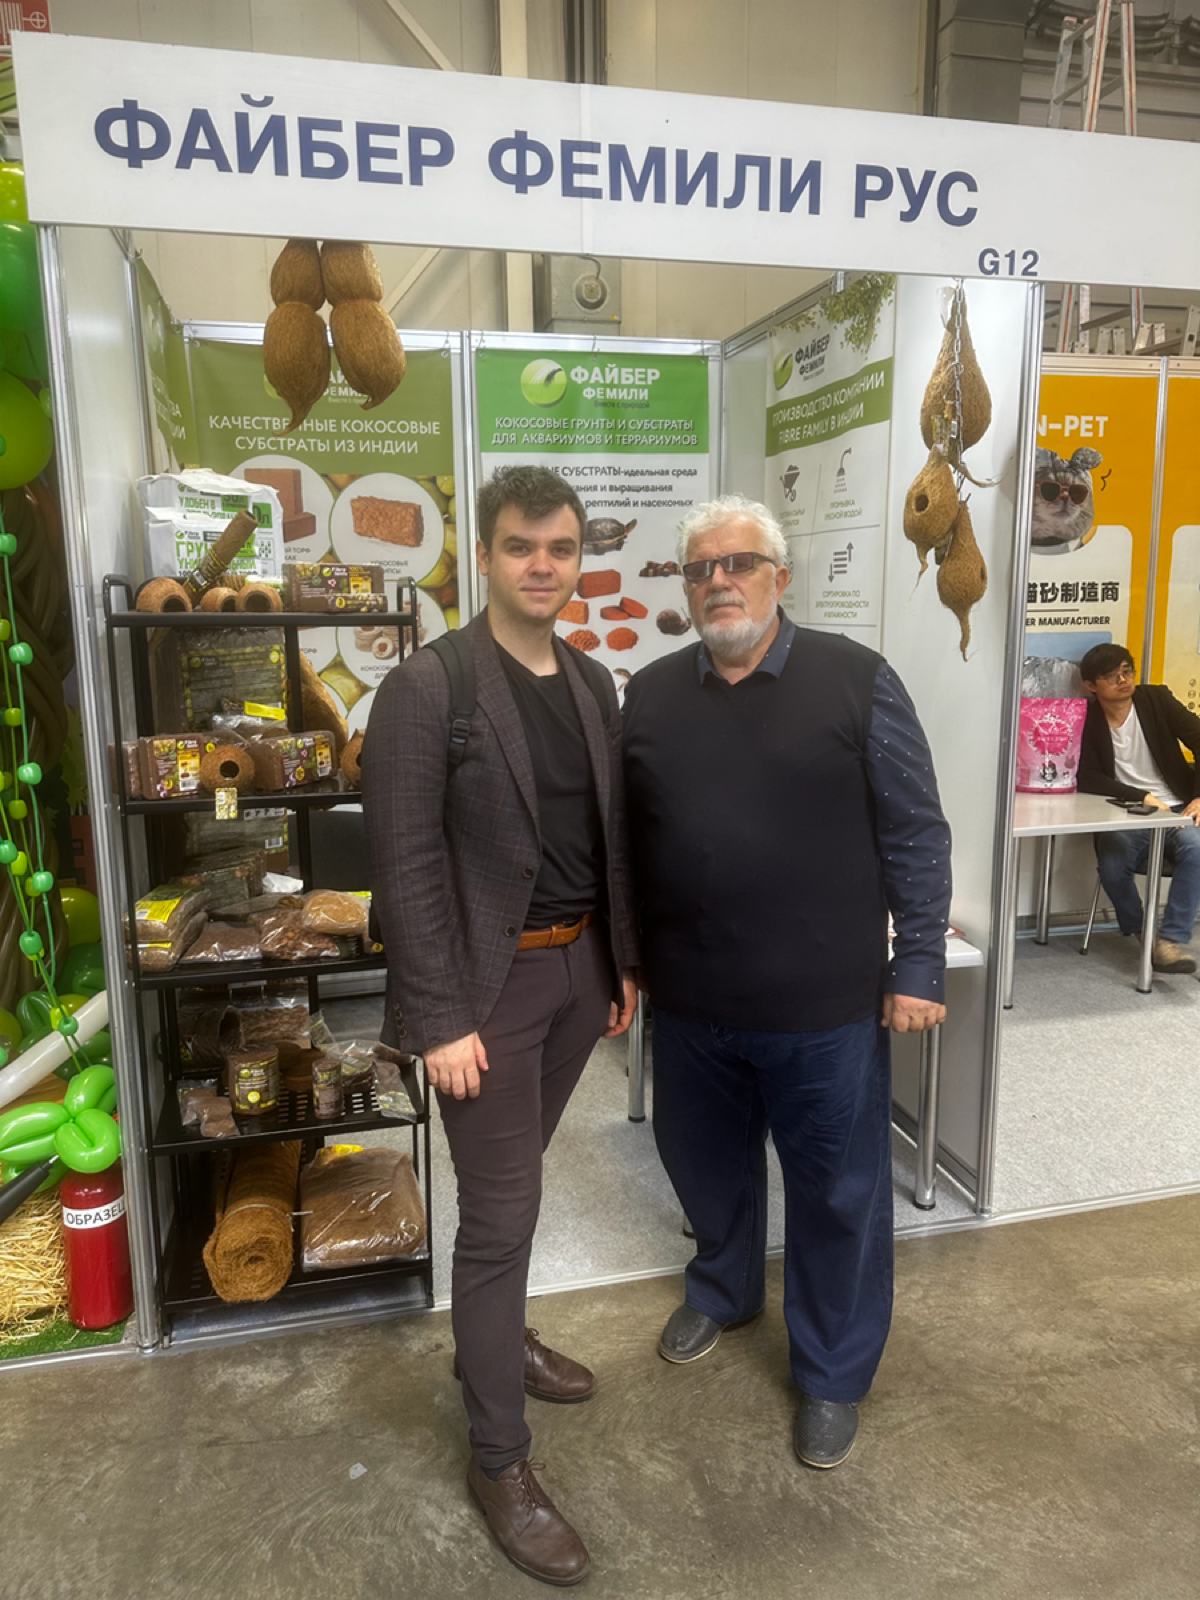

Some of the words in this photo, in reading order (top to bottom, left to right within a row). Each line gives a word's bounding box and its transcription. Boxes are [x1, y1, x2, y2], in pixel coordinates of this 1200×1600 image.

[94, 94, 454, 187] ФАЙБЕР
[488, 130, 822, 215] ФЕМИЛИ
[855, 164, 977, 227] РУС
[978, 248, 1038, 276] G12
[795, 333, 830, 364] ФАЙБЕР
[570, 363, 660, 385] ФАЙБЕР
[582, 386, 649, 401] ФЕМИЛИ
[832, 370, 885, 406] КОМПАНИИ
[208, 415, 337, 433] КАЧЕСТВЕНЫЕ
[341, 419, 441, 435] КОКОСОВЫЕ
[495, 416, 568, 430] КОКОСОВЫЕ
[571, 418, 615, 431] ГРУНТЫ
[618, 419, 626, 431] И
[628, 419, 694, 431] СУБСТРАТЫ
[491, 432, 517, 446] ДЛЯ
[522, 433, 602, 445] АКВАРИУМОВ
[604, 434, 613, 445] И
[615, 434, 698, 446] ТЕРРАРИУМОВ
[779, 426, 801, 445] FIBRE
[235, 436, 330, 453] СУБСТРАТЫ
[335, 439, 355, 453] ИЗ
[359, 440, 418, 455] ИНДИИ
[671, 468, 698, 478] среда
[573, 484, 598, 493] ания
[600, 485, 607, 493] и
[608, 484, 673, 495] выращивания
[584, 497, 631, 509] рептилий
[632, 499, 639, 507] и
[640, 499, 693, 508] насекомых
[175, 541, 214, 559] ГРУН
[1038, 615, 1111, 626] MANUFACTURER
